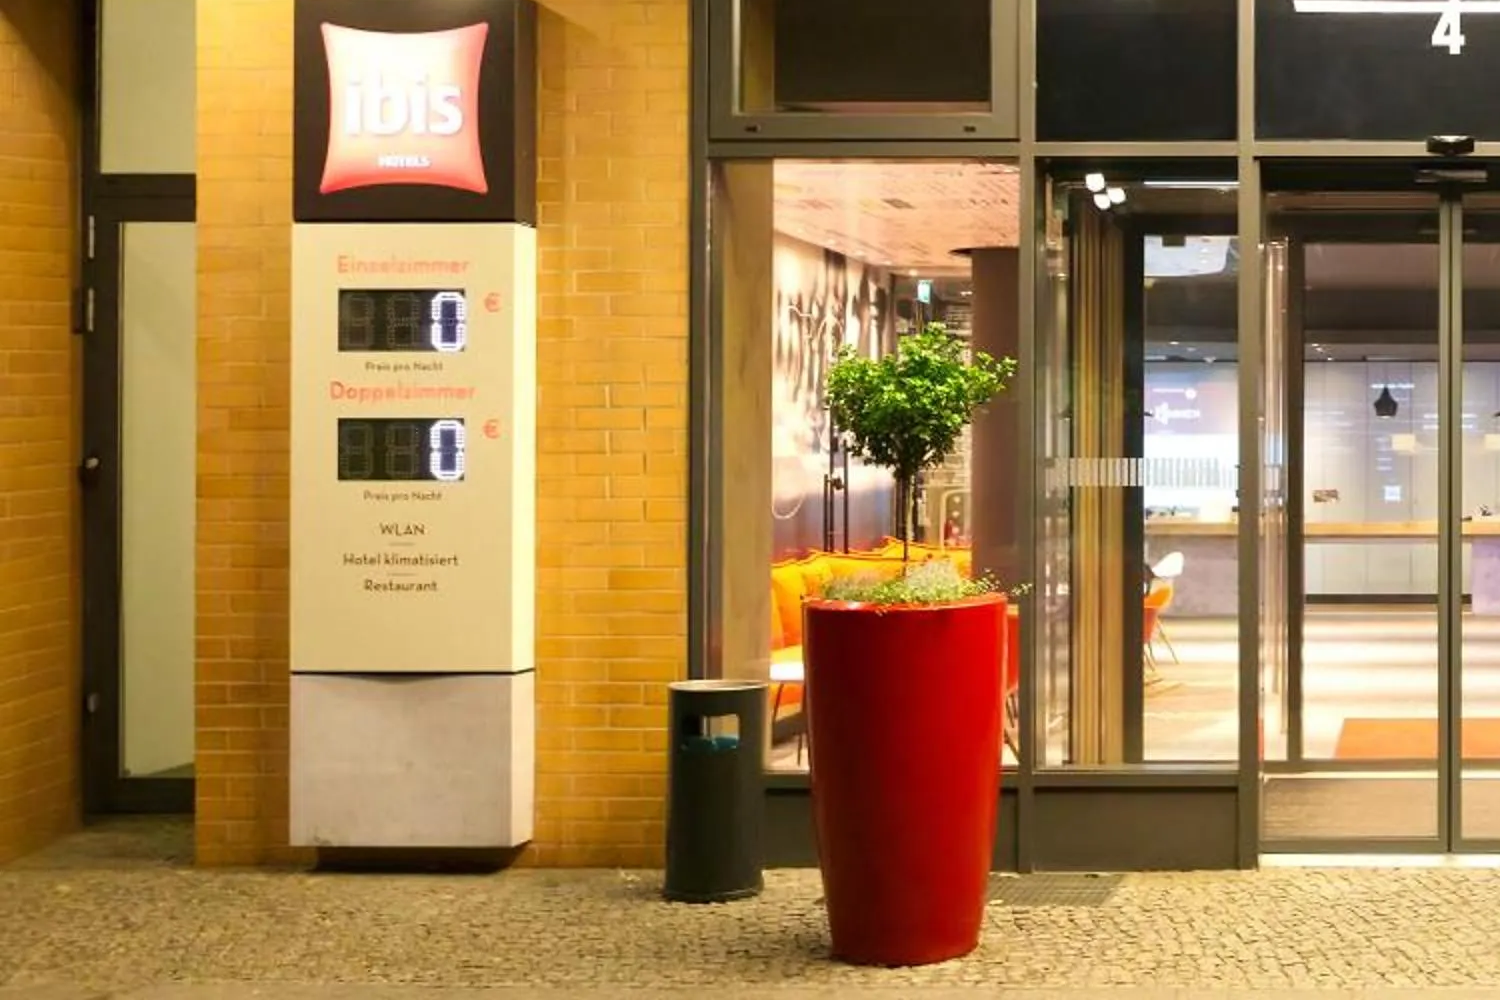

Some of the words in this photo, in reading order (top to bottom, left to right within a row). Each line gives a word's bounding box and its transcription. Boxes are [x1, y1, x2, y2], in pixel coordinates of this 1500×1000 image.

[345, 66, 464, 136] ibis
[337, 254, 470, 274] Einzelzimmer
[431, 290, 467, 353] 0
[329, 381, 477, 403] Doppelzimmer
[429, 419, 465, 482] 0
[379, 523, 425, 536] WLAN
[342, 553, 381, 567] Hotel
[384, 553, 459, 567] klimatisiert
[363, 579, 438, 593] Restaurant
